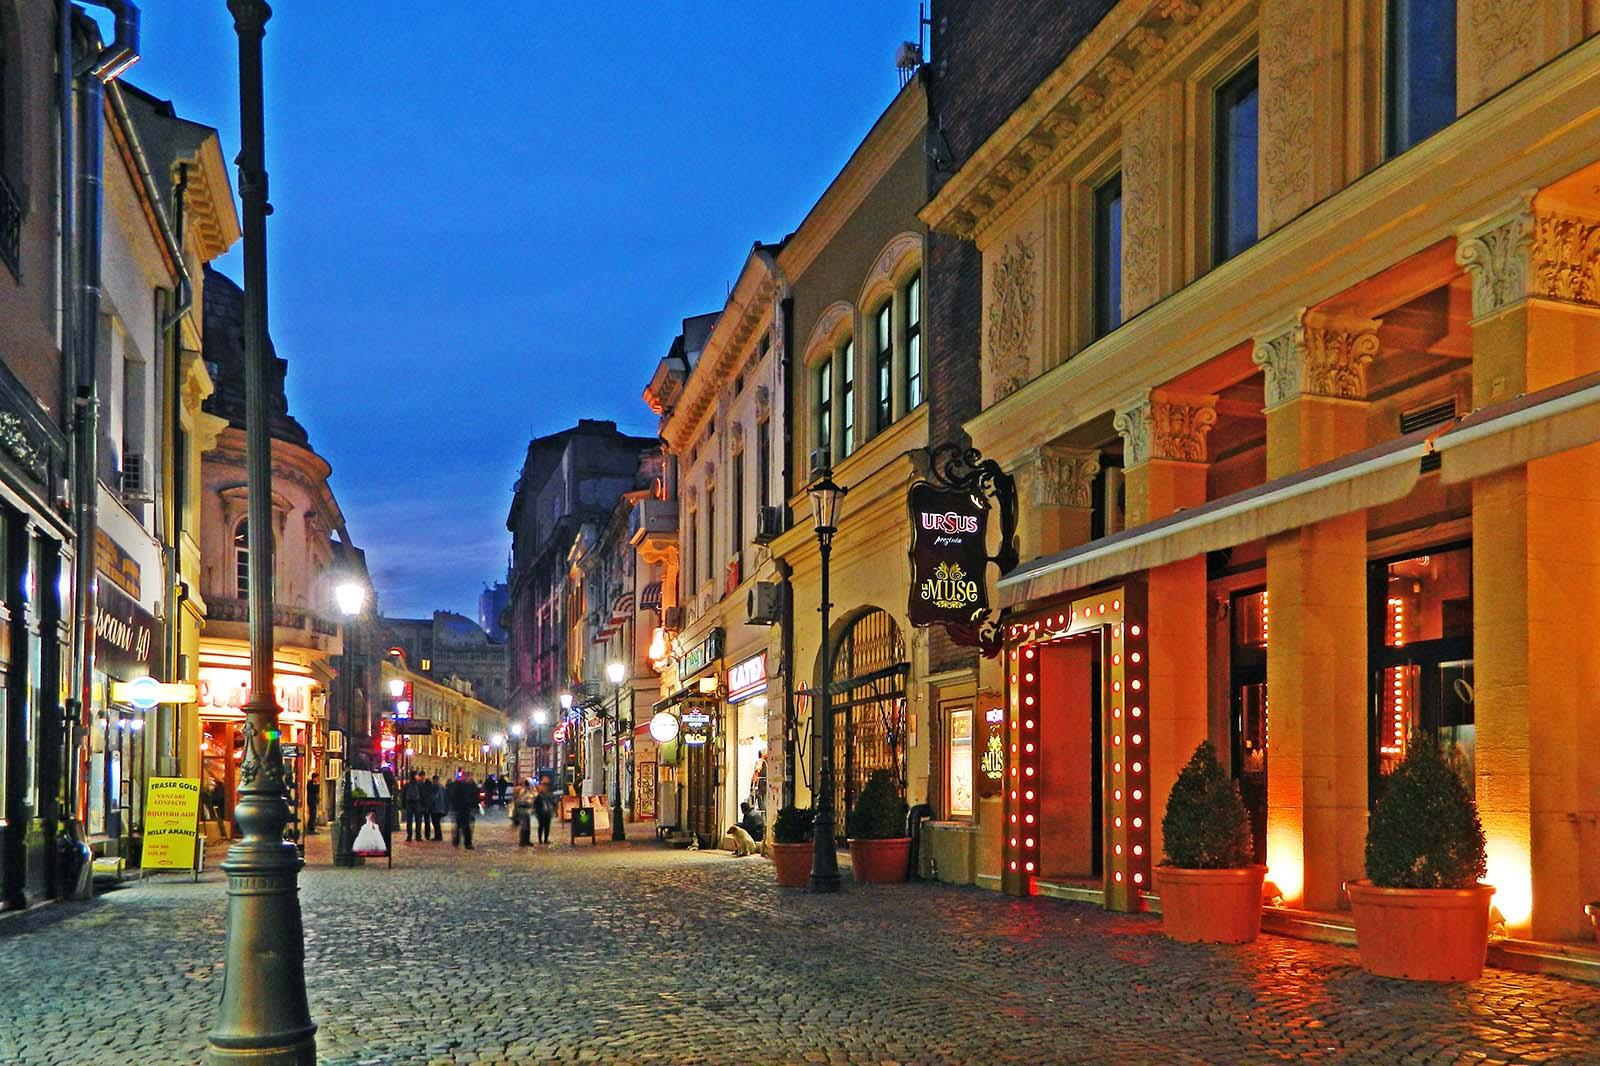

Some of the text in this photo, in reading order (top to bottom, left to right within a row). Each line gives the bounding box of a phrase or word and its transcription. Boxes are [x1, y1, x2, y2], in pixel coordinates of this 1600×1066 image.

[921, 512, 978, 534] URSUS
[136, 626, 151, 663] 40
[178, 782, 198, 792] GOLD
